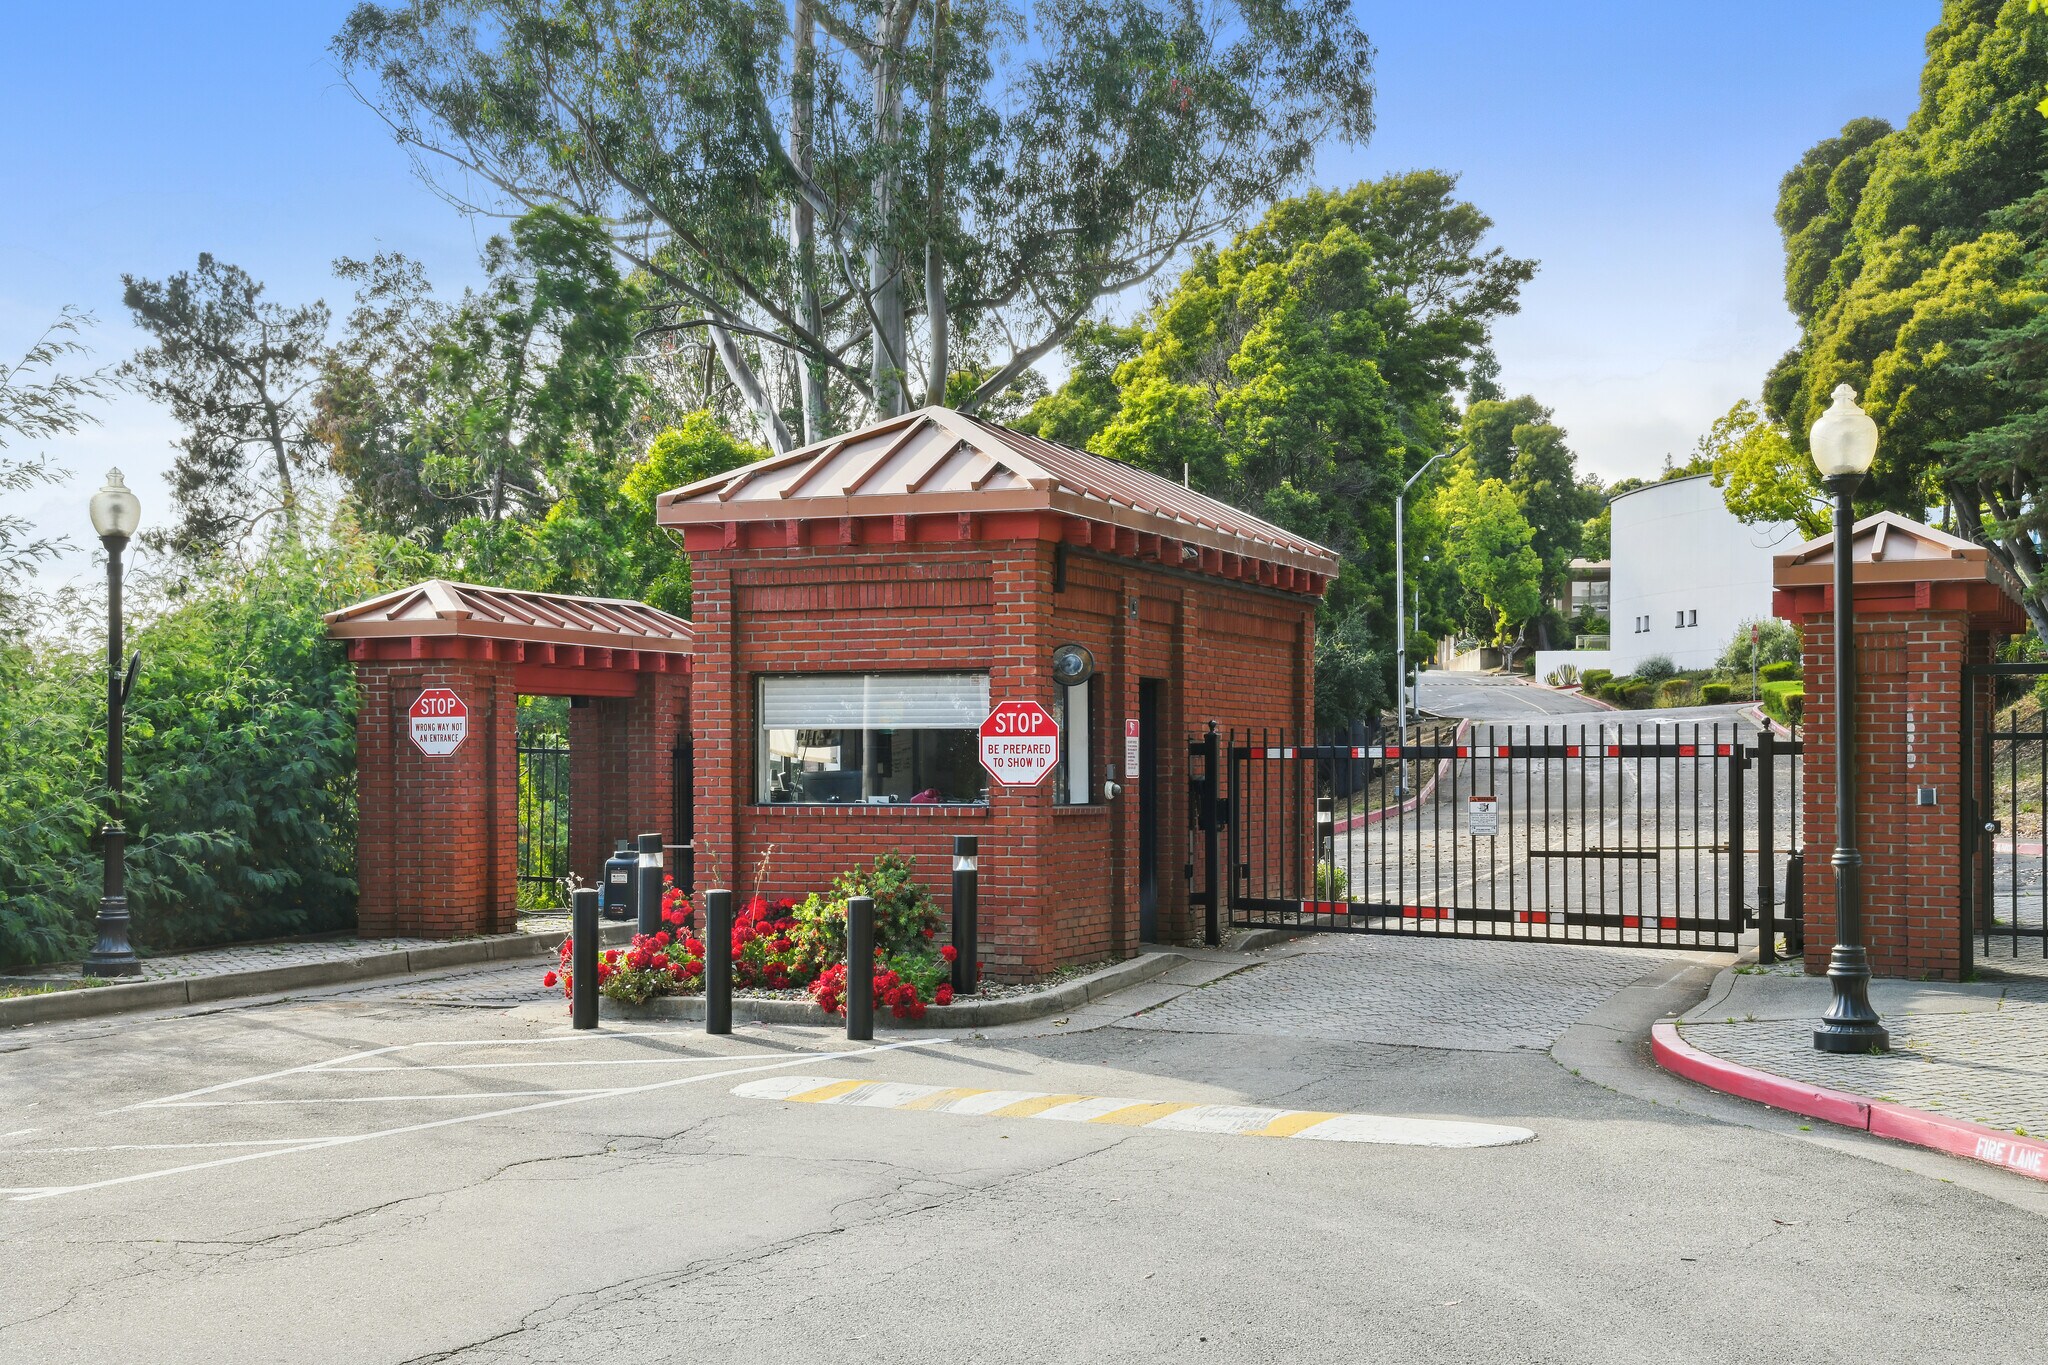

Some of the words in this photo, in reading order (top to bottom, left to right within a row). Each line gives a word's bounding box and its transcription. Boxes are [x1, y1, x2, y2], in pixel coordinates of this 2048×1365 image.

[421, 698, 456, 714] STOP
[415, 723, 436, 731] WRONG
[437, 723, 450, 731] WAY
[452, 723, 463, 731] NOT
[995, 713, 1043, 733] STOP
[419, 734, 428, 742] AN
[430, 734, 459, 742] ENTRANCE
[988, 744, 1000, 754] BE
[1003, 744, 1051, 754] PREPARED
[993, 757, 1004, 767] TO
[1007, 757, 1033, 767] SHOW
[1036, 757, 1046, 767] ID
[1975, 1136, 2006, 1162] FIRE
[2008, 1145, 2044, 1173] LANE
